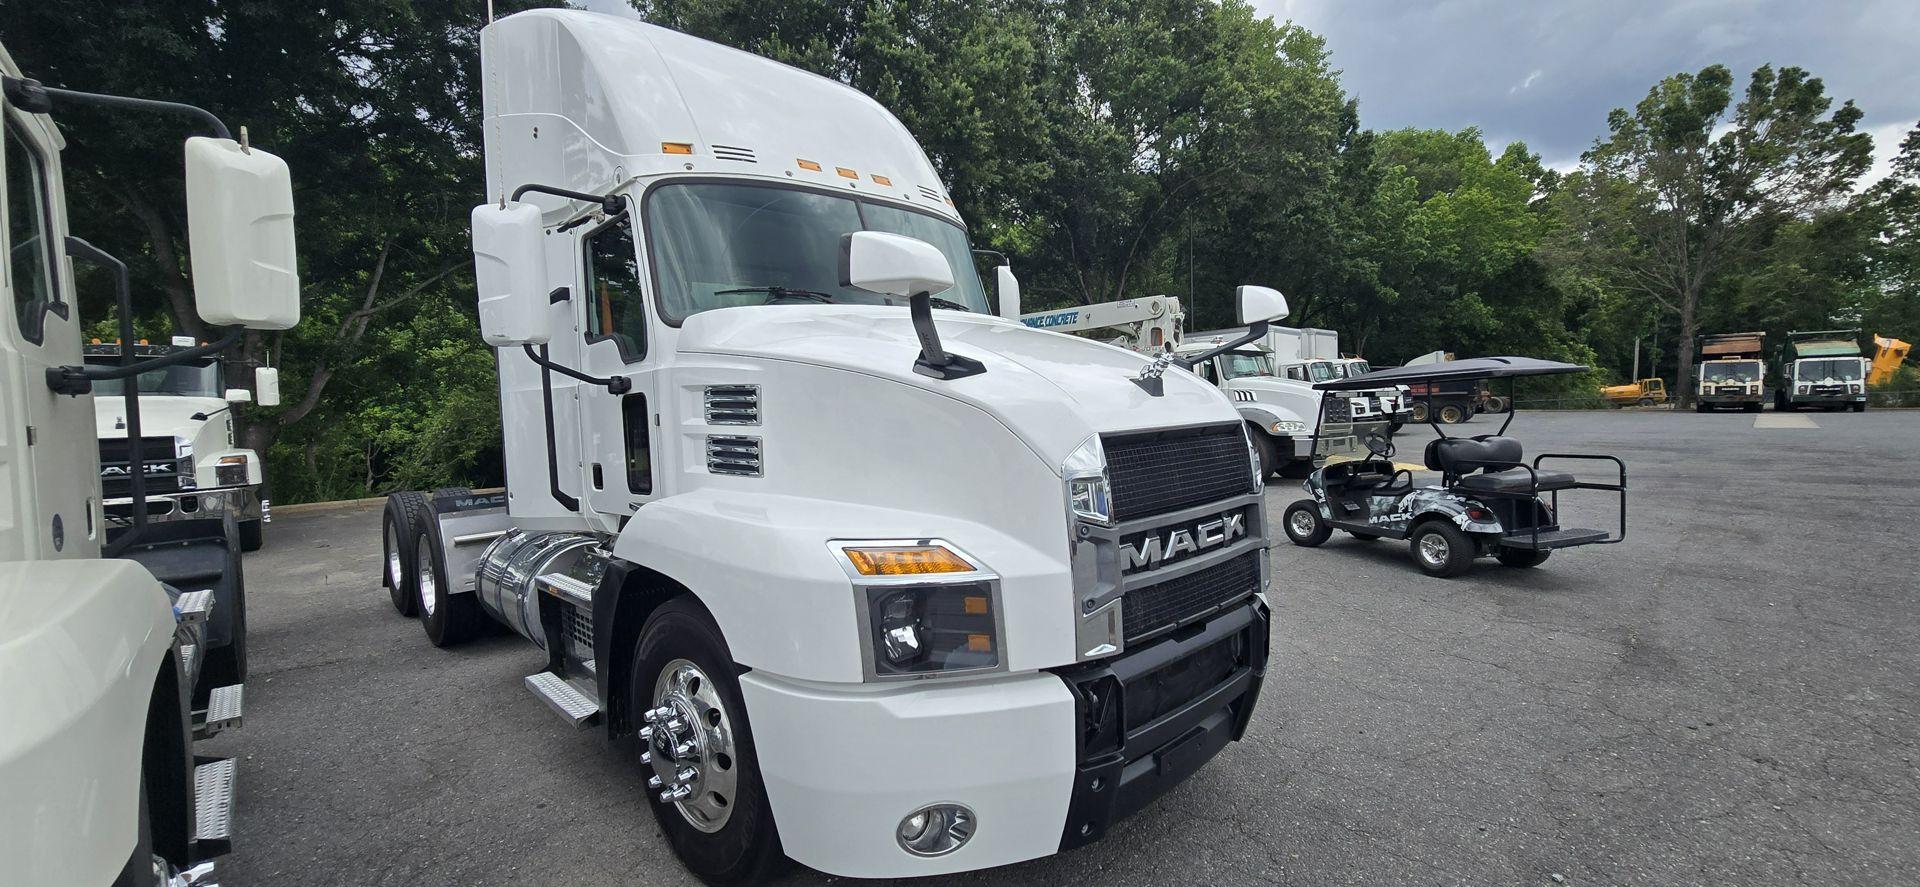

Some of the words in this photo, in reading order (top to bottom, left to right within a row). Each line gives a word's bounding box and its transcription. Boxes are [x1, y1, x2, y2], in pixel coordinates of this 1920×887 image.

[1044, 311, 1079, 327] CONCRETE
[1368, 512, 1414, 524] MACK
[1119, 513, 1245, 571] MACK
